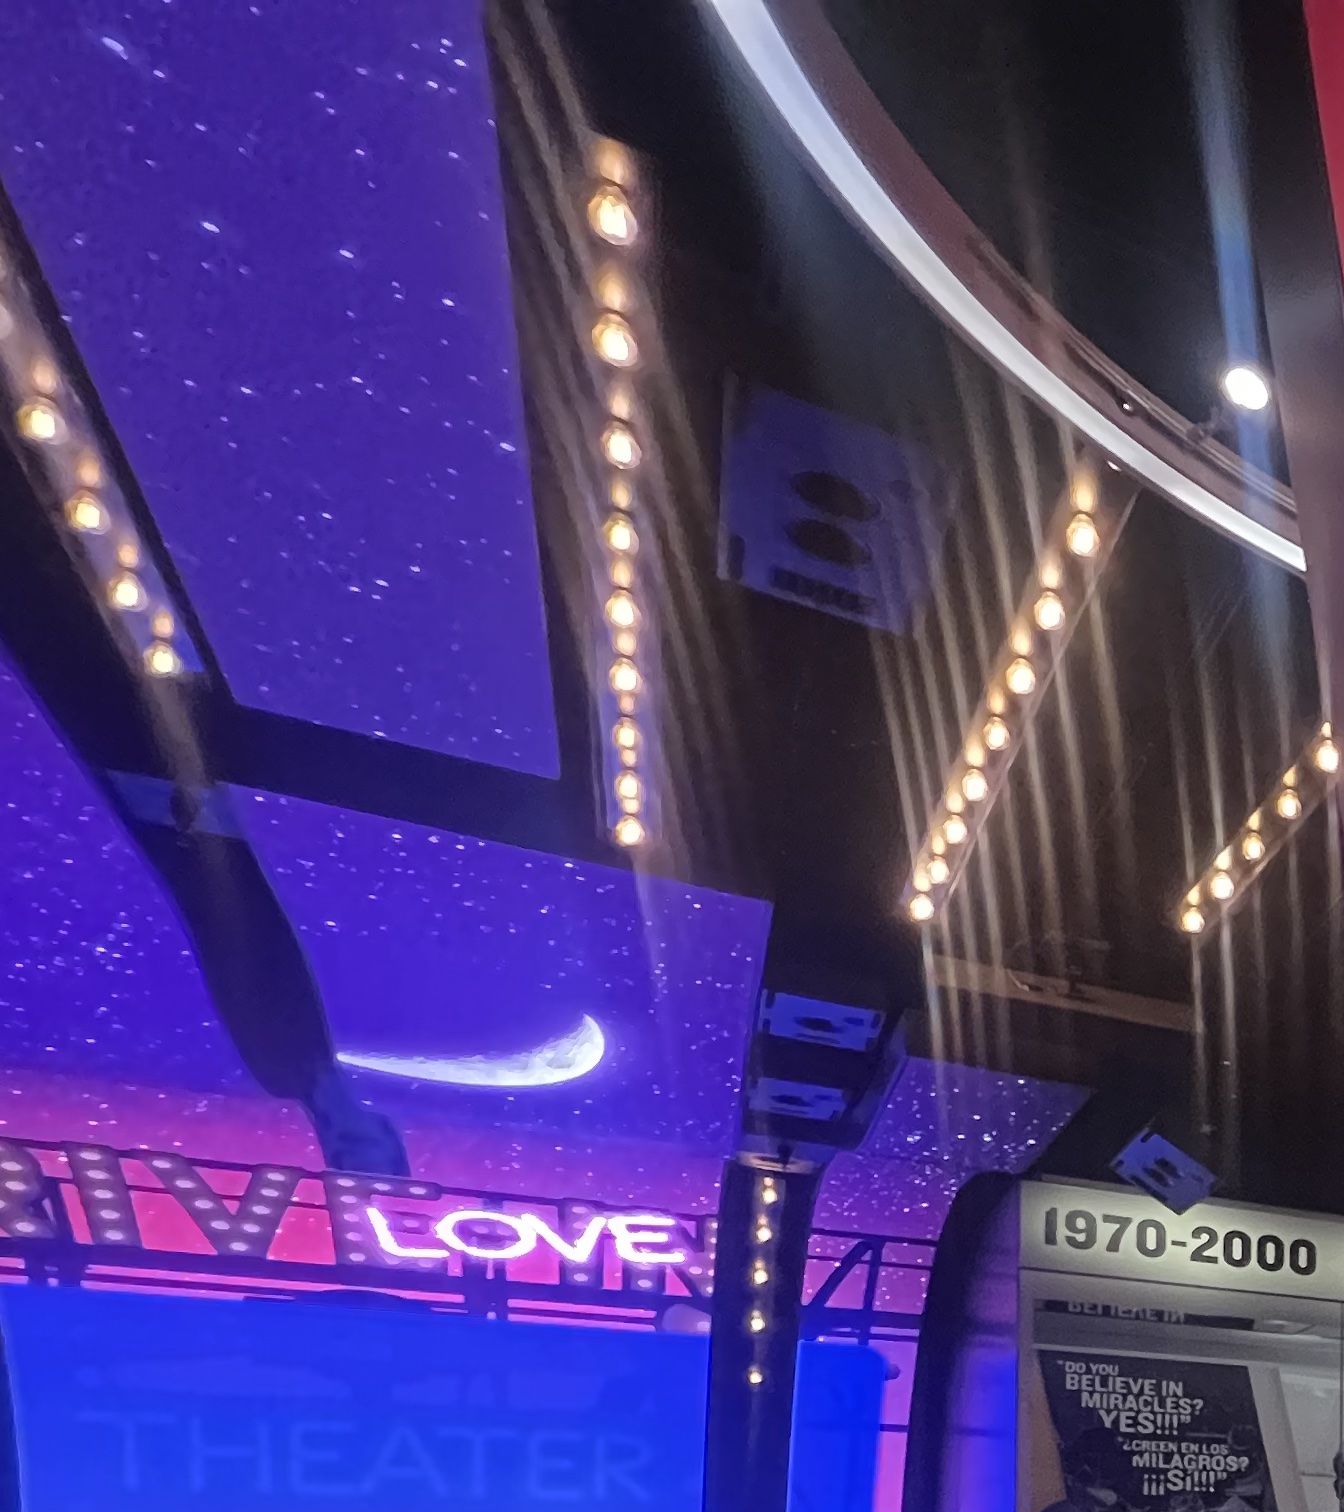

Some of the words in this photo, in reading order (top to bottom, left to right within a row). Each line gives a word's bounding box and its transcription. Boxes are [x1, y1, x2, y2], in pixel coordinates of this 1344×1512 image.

[362, 1204, 687, 1265] LOVE
[1044, 1206, 1317, 1276] 1970-2000
[1090, 1362, 1119, 1376] YOU
[1065, 1374, 1156, 1397] BELIEVE
[1161, 1378, 1183, 1397] IN
[1081, 1391, 1203, 1415] MIRACLES?
[72, 1408, 654, 1503] THEATER
[1180, 1442, 1200, 1455] EN
[1202, 1443, 1229, 1456] LOS
[1132, 1453, 1249, 1473] MILAGROS?
